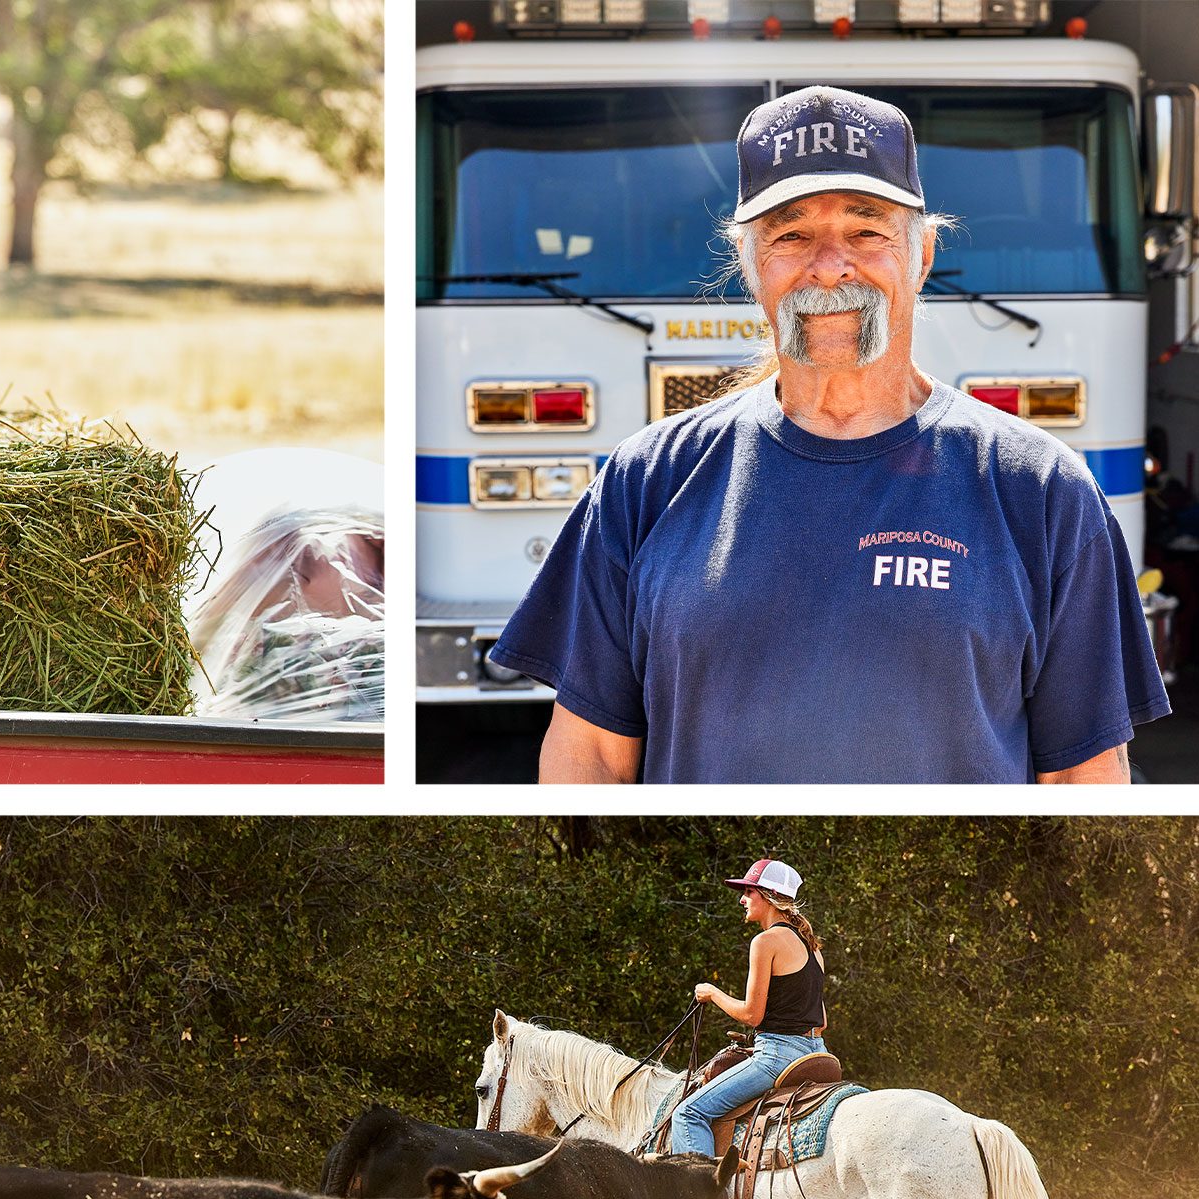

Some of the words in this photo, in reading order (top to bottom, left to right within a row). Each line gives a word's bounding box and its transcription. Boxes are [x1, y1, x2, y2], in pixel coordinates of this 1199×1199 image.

[758, 96, 821, 147] MARIPOSA
[833, 99, 884, 138] COUNTY
[772, 121, 868, 167] FIRE
[858, 530, 921, 551] MARIPOSA
[922, 530, 969, 558] COUNTY
[873, 555, 951, 589] FIRE
